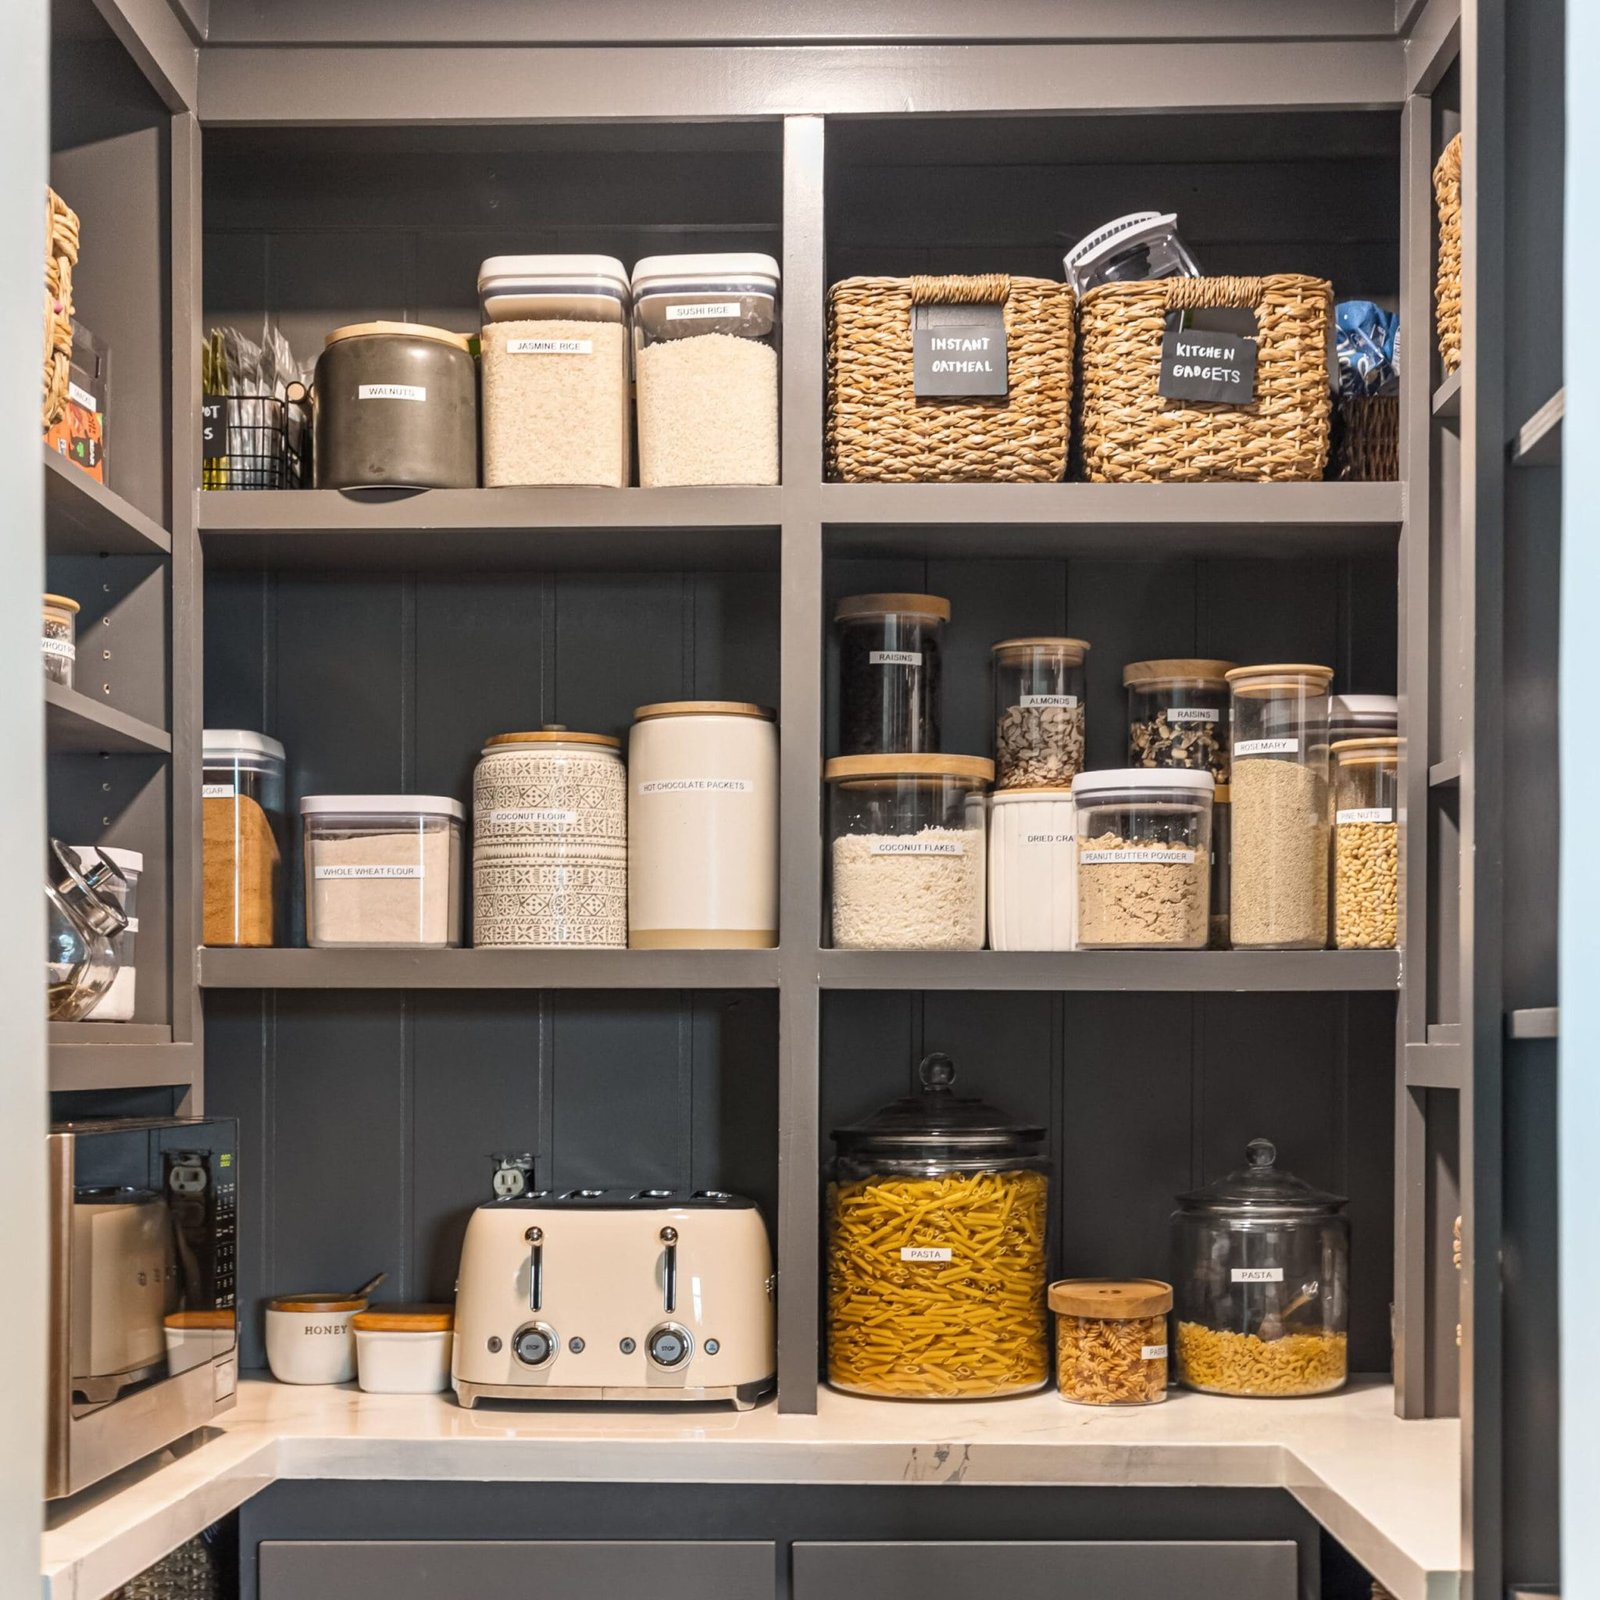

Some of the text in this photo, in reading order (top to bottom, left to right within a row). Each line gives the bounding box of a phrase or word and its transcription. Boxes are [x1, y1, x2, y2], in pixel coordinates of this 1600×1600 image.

[676, 305, 729, 317] SUSHI RICE
[517, 342, 581, 352] JASMINE RICE
[930, 337, 992, 352] INSTANT
[1176, 342, 1236, 361] KITCHEN
[931, 360, 994, 373] OATMEAL
[1172, 364, 1241, 384] GADGETS
[368, 387, 415, 397] WALNUTS
[879, 653, 913, 662] RAISINS
[1029, 697, 1070, 706] ALMONDS
[1177, 710, 1211, 719] RAISINS
[1239, 742, 1287, 753] ROSEMARY
[643, 781, 745, 792] HOT CHOCOLATE PACKETS
[495, 812, 566, 821] COCONUT FLOUR
[1357, 811, 1380, 819] NUTS
[1027, 835, 1054, 843] DRIED
[878, 843, 956, 853] COCONUT FLAKES
[1085, 852, 1188, 861] PEANUT BUTTER POWDER
[323, 867, 415, 876] WHOLE WHEAT FLOUR
[910, 1249, 941, 1259] PASTA
[1241, 1271, 1273, 1280] PASTA
[304, 1325, 349, 1336] HONEY
[525, 1343, 540, 1351] STOP
